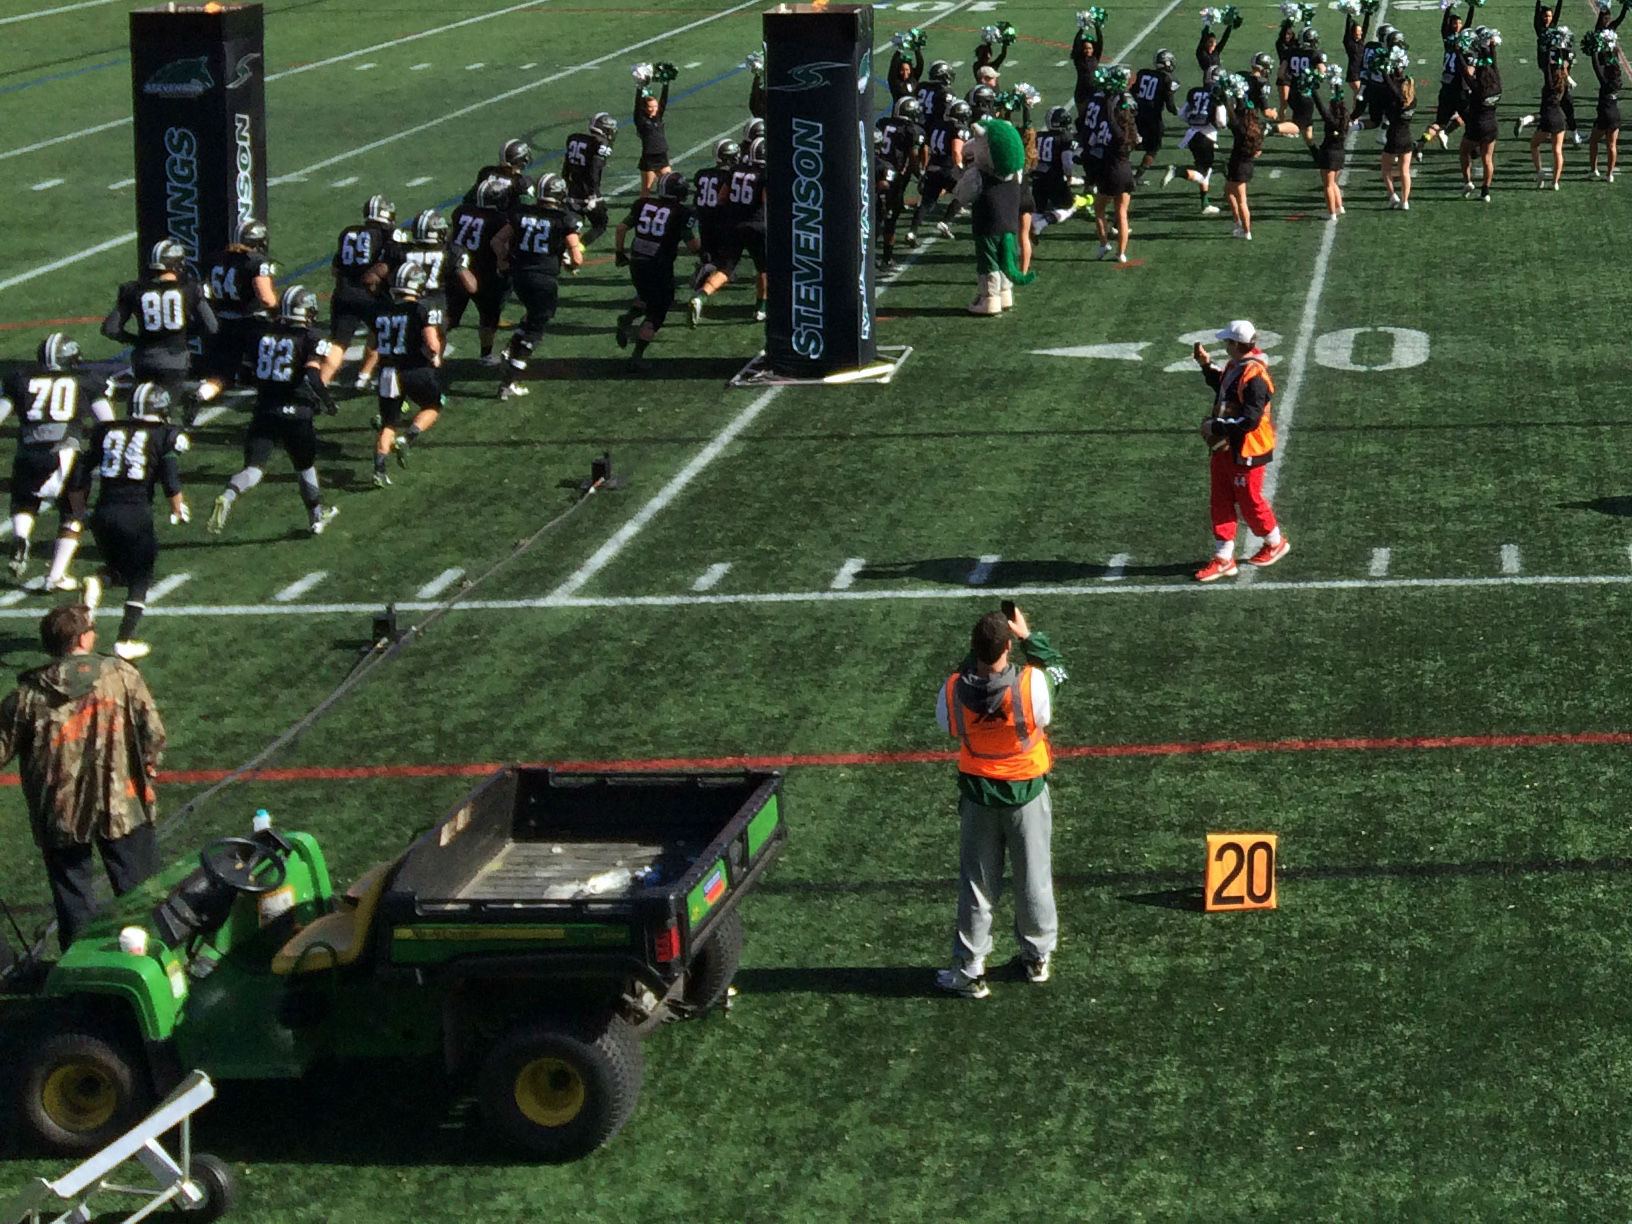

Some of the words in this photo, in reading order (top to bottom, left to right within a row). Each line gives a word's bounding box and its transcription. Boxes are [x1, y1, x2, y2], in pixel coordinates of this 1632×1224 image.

[1139, 75, 1159, 101] 50
[697, 177, 718, 207] 36
[730, 171, 756, 205] 56
[455, 214, 484, 251] 73
[519, 216, 551, 253] 72
[637, 203, 671, 236] 58
[341, 231, 372, 265] 69
[791, 118, 824, 360] STEVENSON
[211, 265, 240, 301] 64
[142, 290, 183, 332] 80
[375, 314, 408, 355] 27
[257, 335, 293, 382] 82
[27, 377, 77, 421] 70
[100, 429, 148, 480] 84
[1213, 840, 1274, 906] 20
